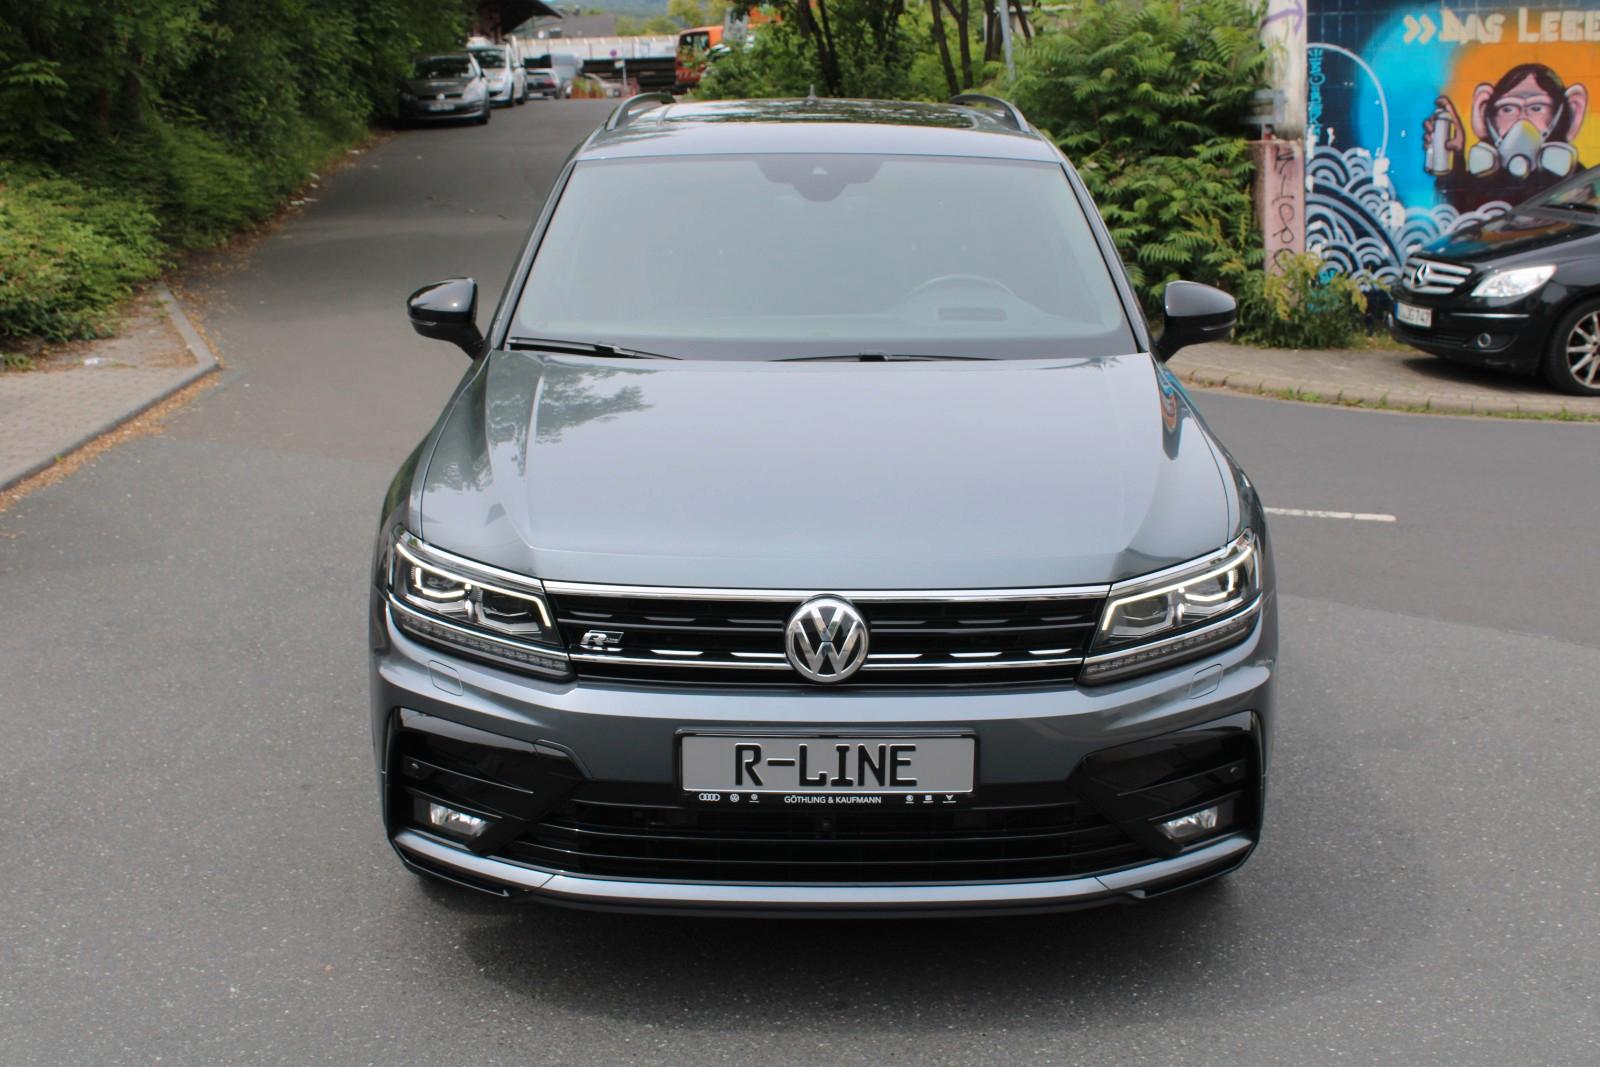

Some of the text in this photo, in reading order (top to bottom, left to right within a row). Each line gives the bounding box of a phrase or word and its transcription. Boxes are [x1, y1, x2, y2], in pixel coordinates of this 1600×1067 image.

[735, 743, 917, 787] R-LINE
[783, 795, 882, 804] GÖTHLING & KAUFMANN
